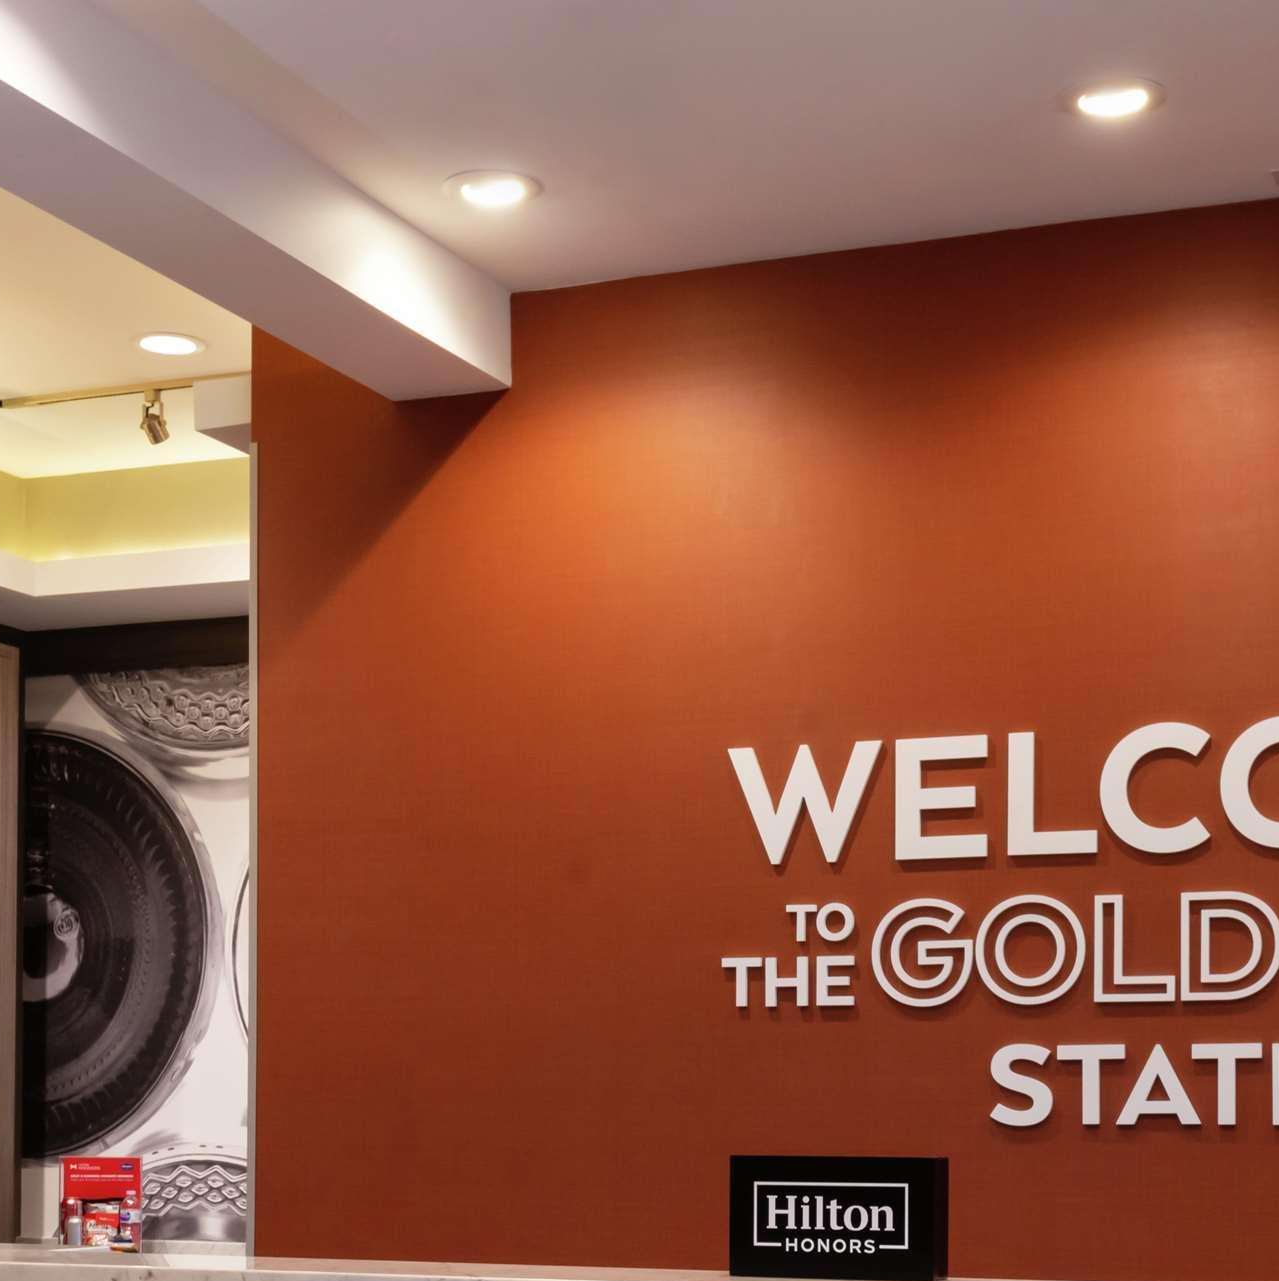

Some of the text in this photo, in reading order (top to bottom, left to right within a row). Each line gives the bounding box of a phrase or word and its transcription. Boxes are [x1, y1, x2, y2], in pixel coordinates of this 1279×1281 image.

[786, 903, 854, 941] TO
[721, 955, 855, 1007] THE
[767, 1195, 895, 1231] Hilton
[785, 1237, 876, 1254] HONORS
